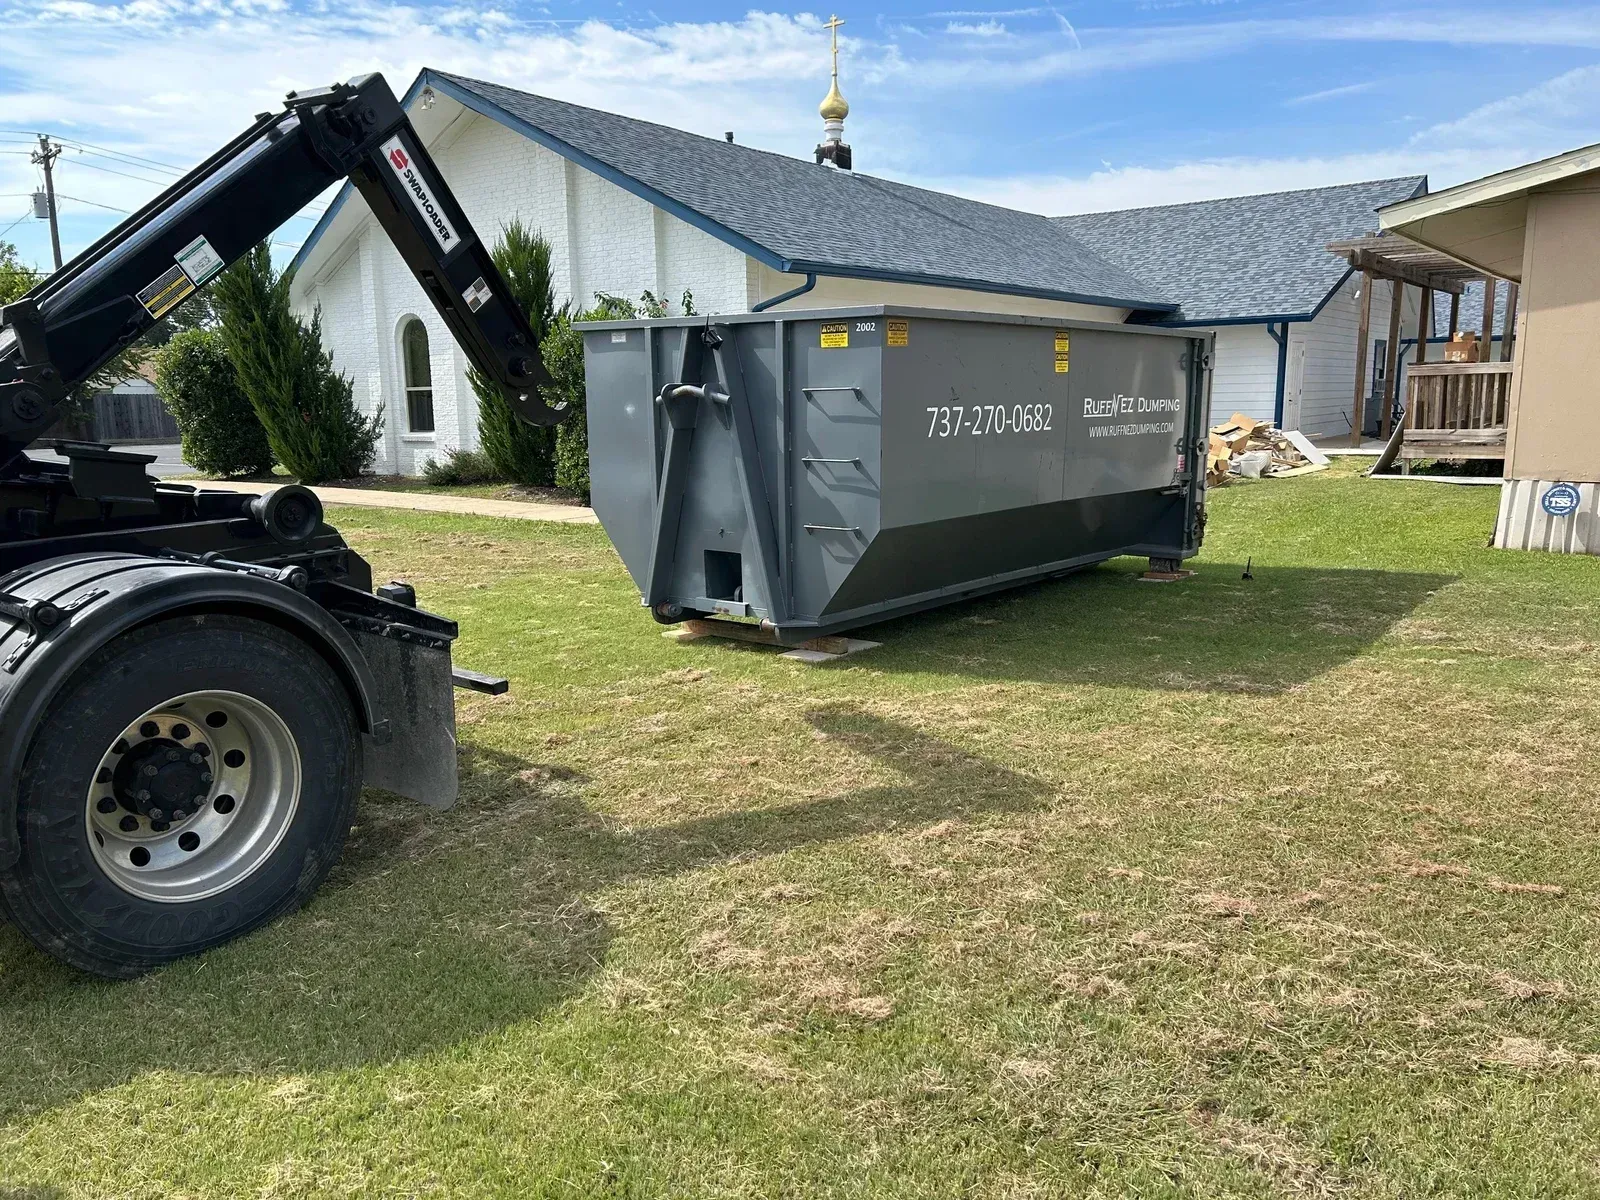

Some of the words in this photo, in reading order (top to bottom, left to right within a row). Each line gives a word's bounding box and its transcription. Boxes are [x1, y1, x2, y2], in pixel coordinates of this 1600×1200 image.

[403, 168, 451, 242] SWAPLOADER
[826, 324, 847, 333] CAUTION
[855, 322, 876, 332] 2002
[889, 323, 908, 331] CAUTION
[926, 403, 1053, 438] 737-270-0682
[1088, 422, 1175, 439] WWW.RUFFNEZDUMPING.COM
[1549, 497, 1573, 507] TSS
